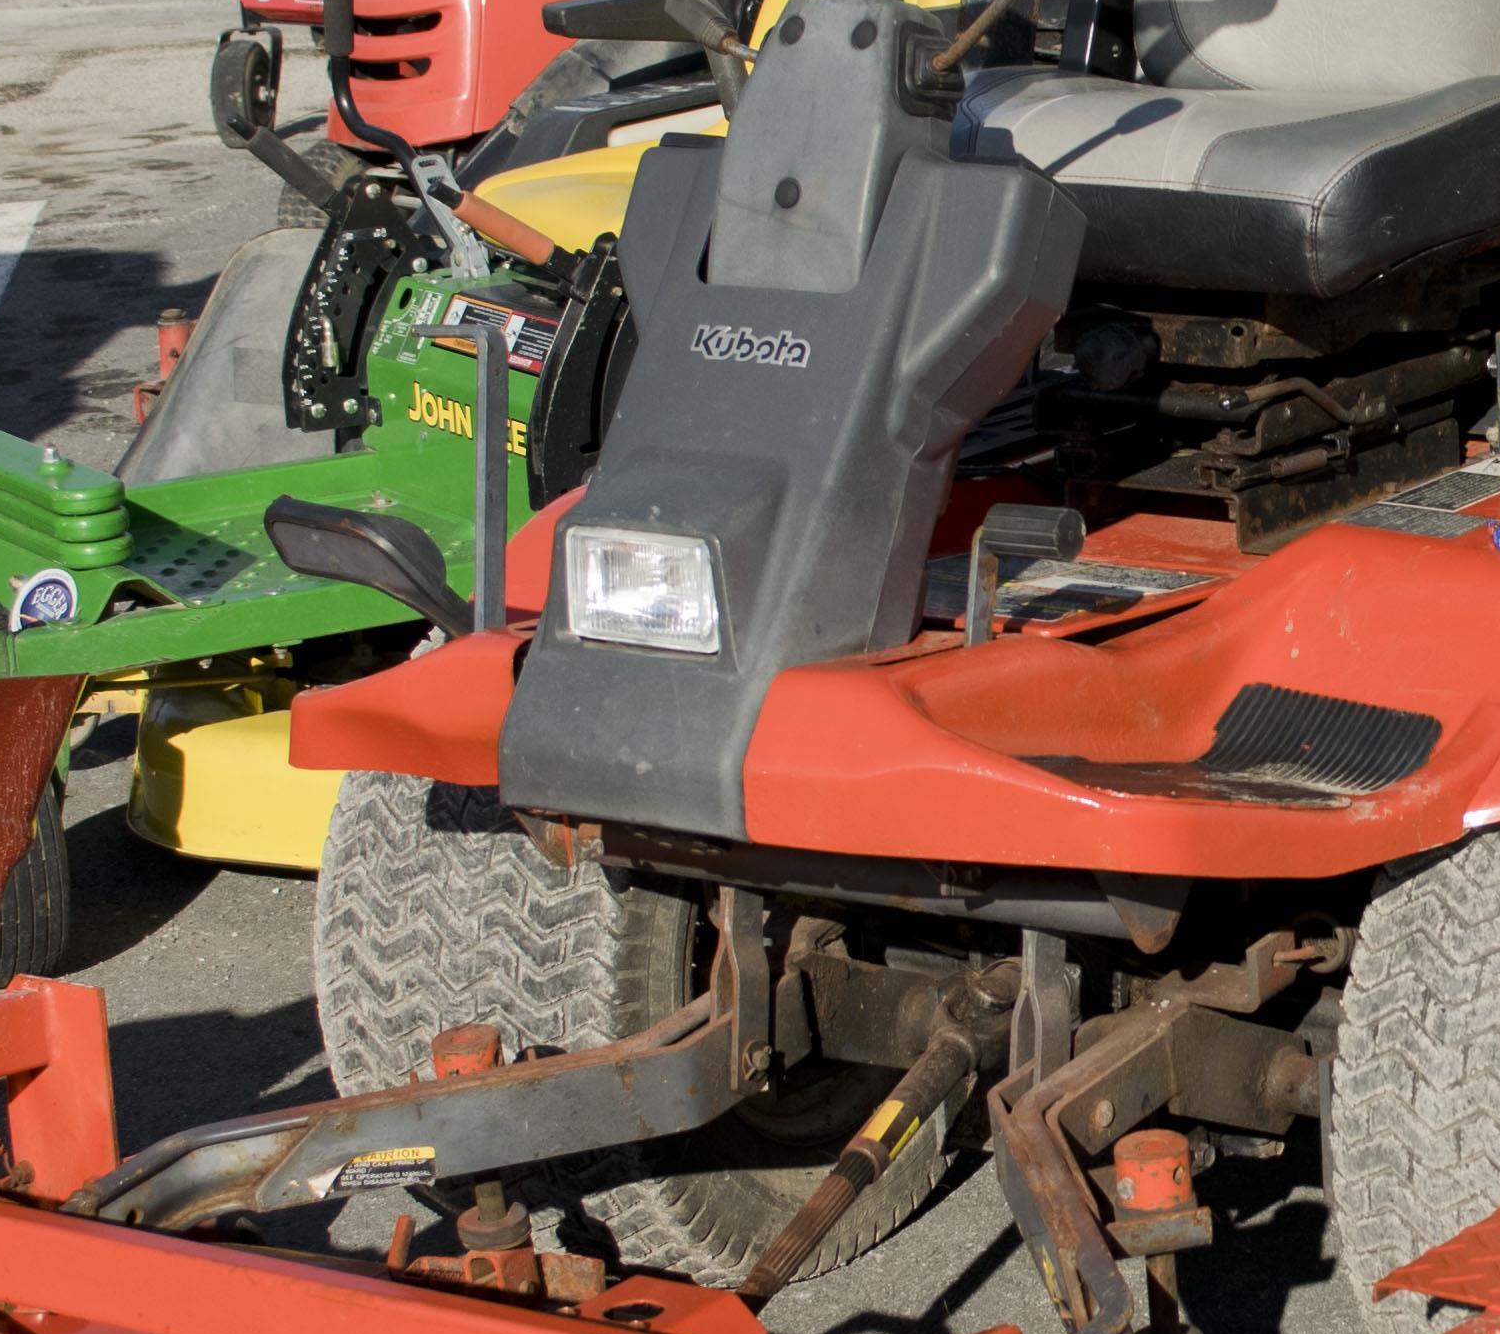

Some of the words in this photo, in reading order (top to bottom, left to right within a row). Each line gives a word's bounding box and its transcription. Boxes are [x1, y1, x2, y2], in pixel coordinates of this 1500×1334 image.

[691, 325, 811, 368] Kubota
[407, 380, 473, 440] JOHN
[360, 1149, 420, 1161] CAUTION
